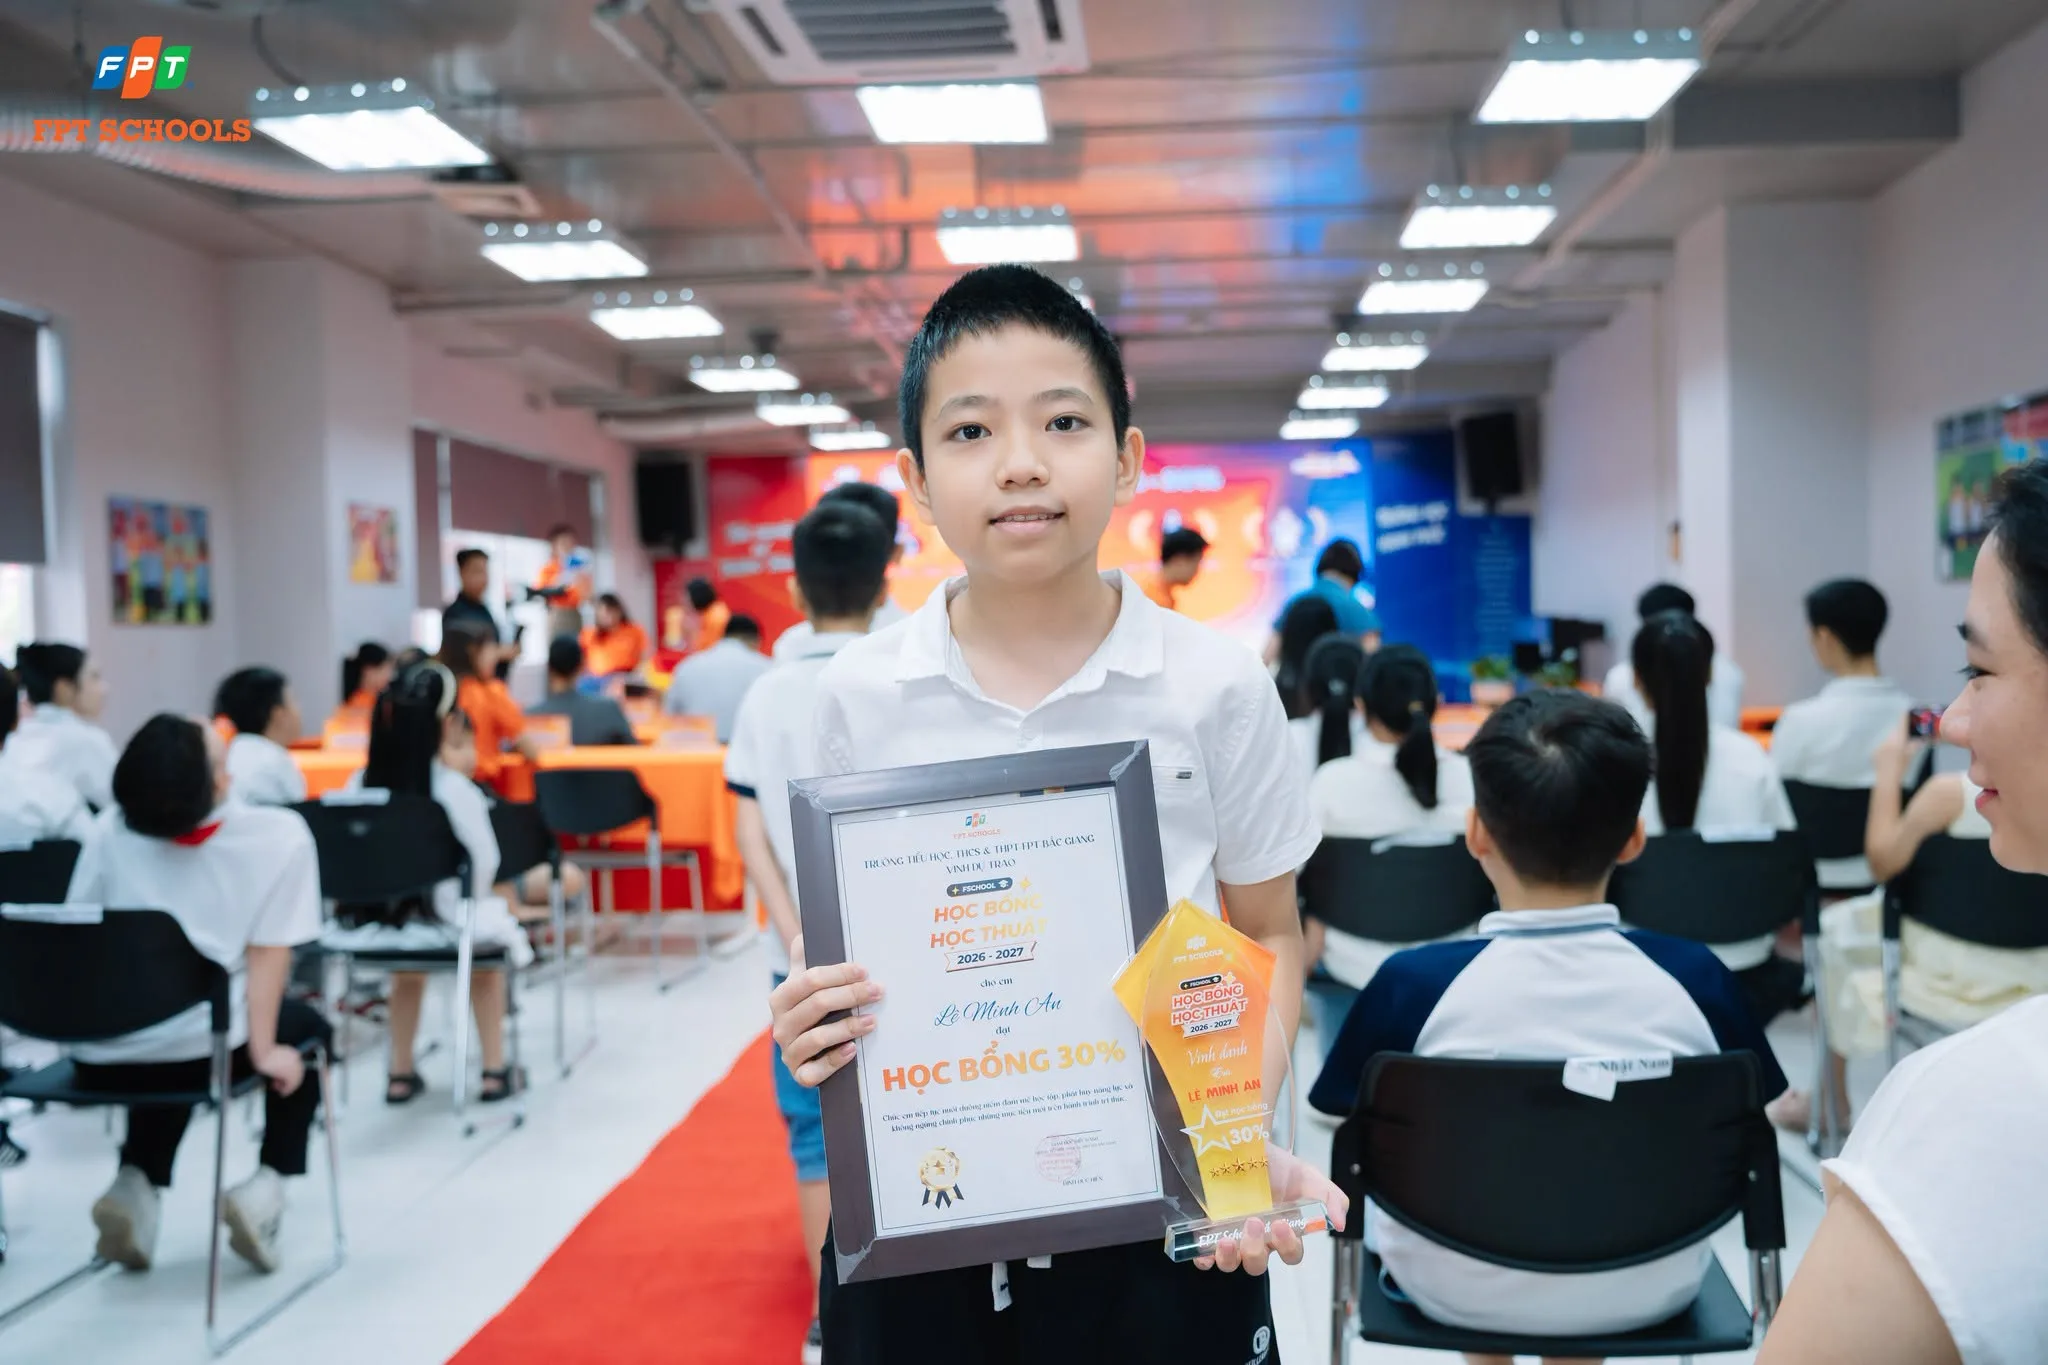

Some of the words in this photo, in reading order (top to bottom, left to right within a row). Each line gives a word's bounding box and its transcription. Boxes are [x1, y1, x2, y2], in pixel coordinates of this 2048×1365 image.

[956, 847, 981, 858] THCS
[983, 847, 991, 855] &
[994, 842, 1019, 854] THPT
[1021, 839, 1039, 850] FPT
[1064, 834, 1095, 846] GIANG
[946, 862, 970, 874] VINH
[989, 858, 1016, 869] TRAO
[962, 883, 996, 893] FSCHOOL
[934, 902, 978, 925] HỌC
[930, 927, 975, 950] HỌC
[957, 952, 986, 965] 2026
[995, 947, 1024, 960] 2027
[980, 978, 997, 987] cho
[998, 977, 1013, 986] em
[934, 1003, 961, 1026] Lê
[963, 1000, 1020, 1022] Minh
[1024, 992, 1063, 1017] An
[1173, 993, 1202, 1008] HỌC
[1172, 1009, 1201, 1024] HỌC
[1204, 999, 1246, 1017] THUẬT
[995, 1026, 1011, 1036] đạt
[1190, 1023, 1209, 1033] 2026
[1214, 1019, 1232, 1029] 2027
[1186, 1044, 1216, 1066] Vinh
[1219, 1040, 1248, 1060] danh
[882, 1060, 952, 1095] HỌC
[958, 1040, 1051, 1082] BỔNG
[1057, 1039, 1127, 1070] 30%
[1640, 1057, 1669, 1070] Nam
[1188, 1087, 1201, 1102] LÊ
[1206, 1083, 1239, 1099] MINH
[1244, 1079, 1262, 1092] AN
[1229, 1122, 1270, 1144] 30%
[1199, 1231, 1222, 1247] FPT
